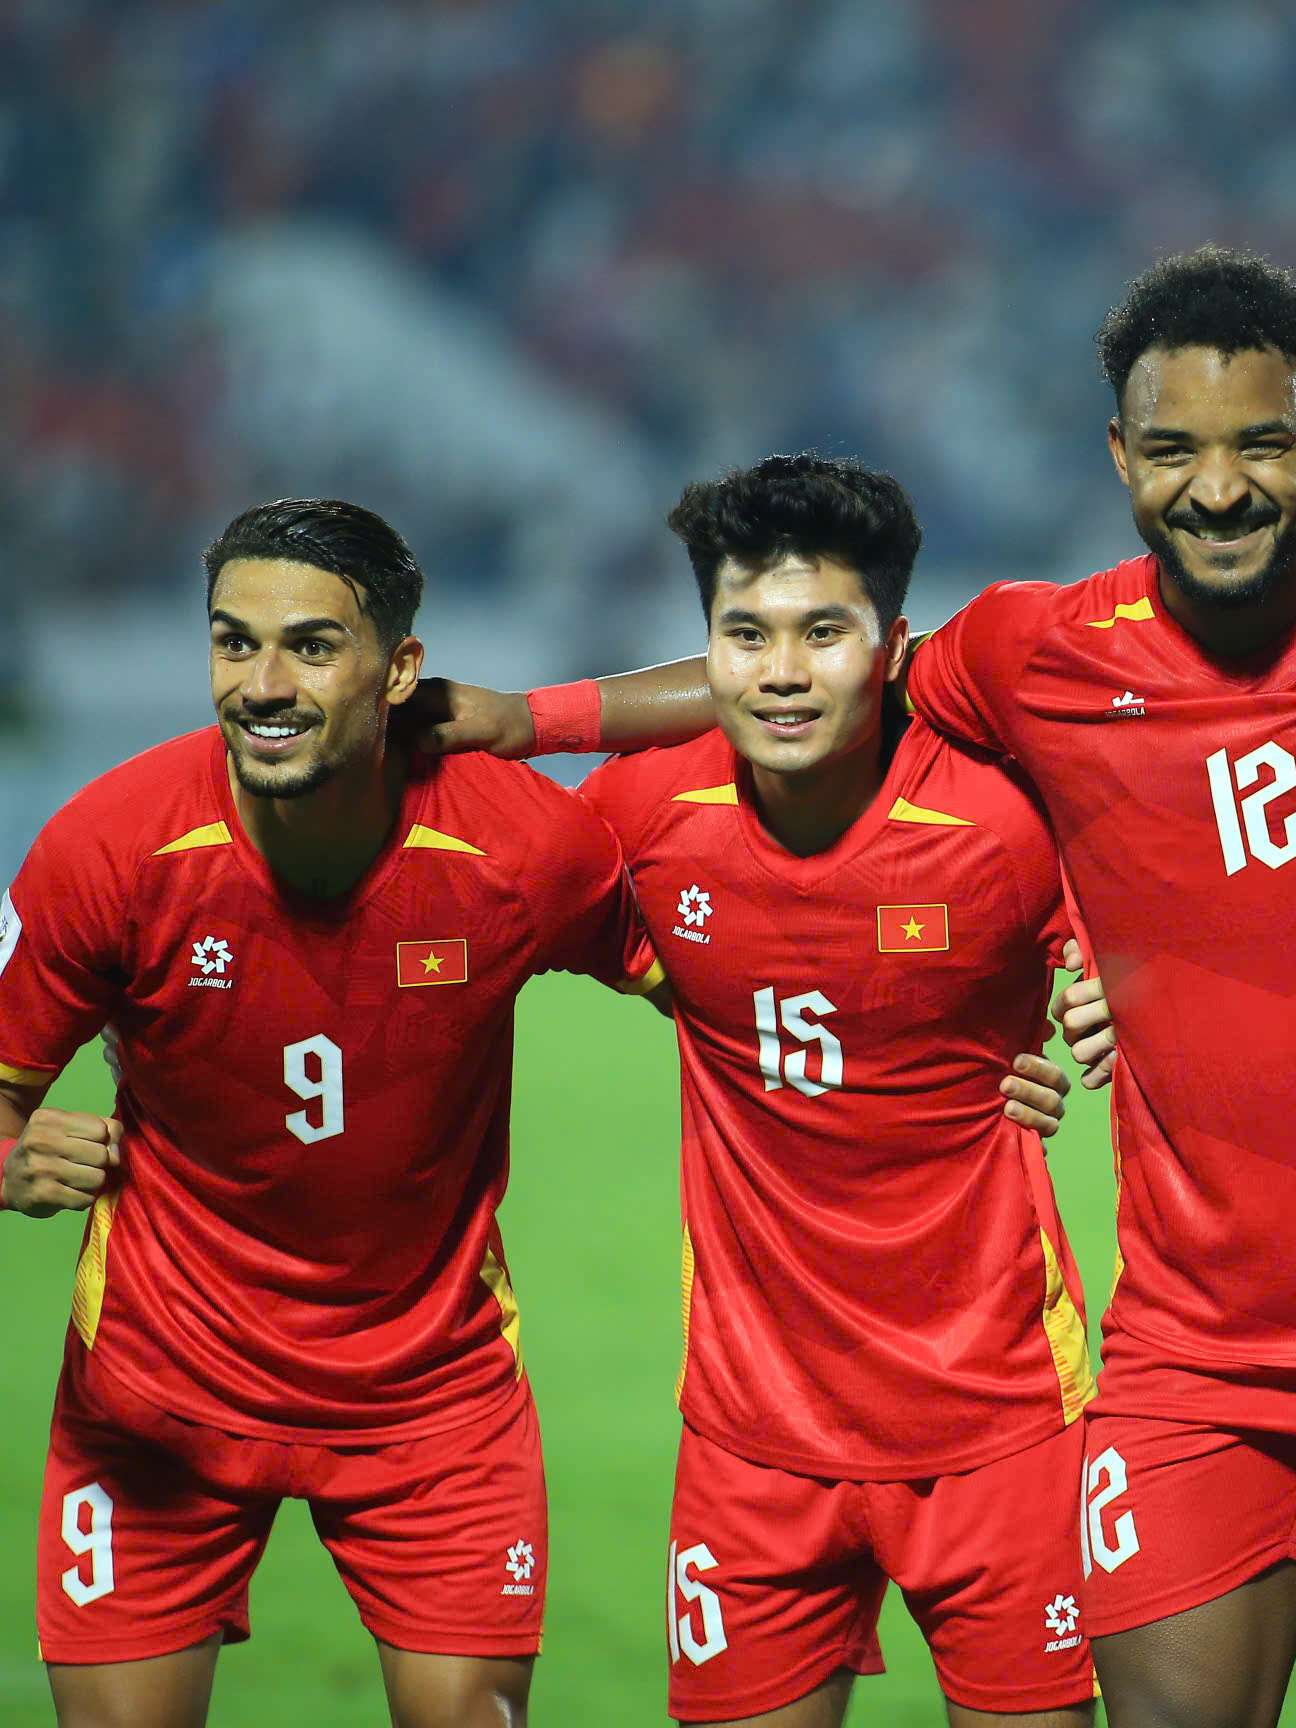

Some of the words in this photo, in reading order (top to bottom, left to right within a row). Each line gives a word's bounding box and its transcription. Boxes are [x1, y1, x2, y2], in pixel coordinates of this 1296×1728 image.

[187, 977, 232, 990] JOGARBOLA
[671, 925, 711, 945] JOGARBOLA
[283, 1033, 345, 1145] 9
[753, 986, 844, 1097] 15
[61, 1482, 115, 1607] 9
[1079, 1445, 1141, 1582] 12
[667, 1539, 728, 1666] 15
